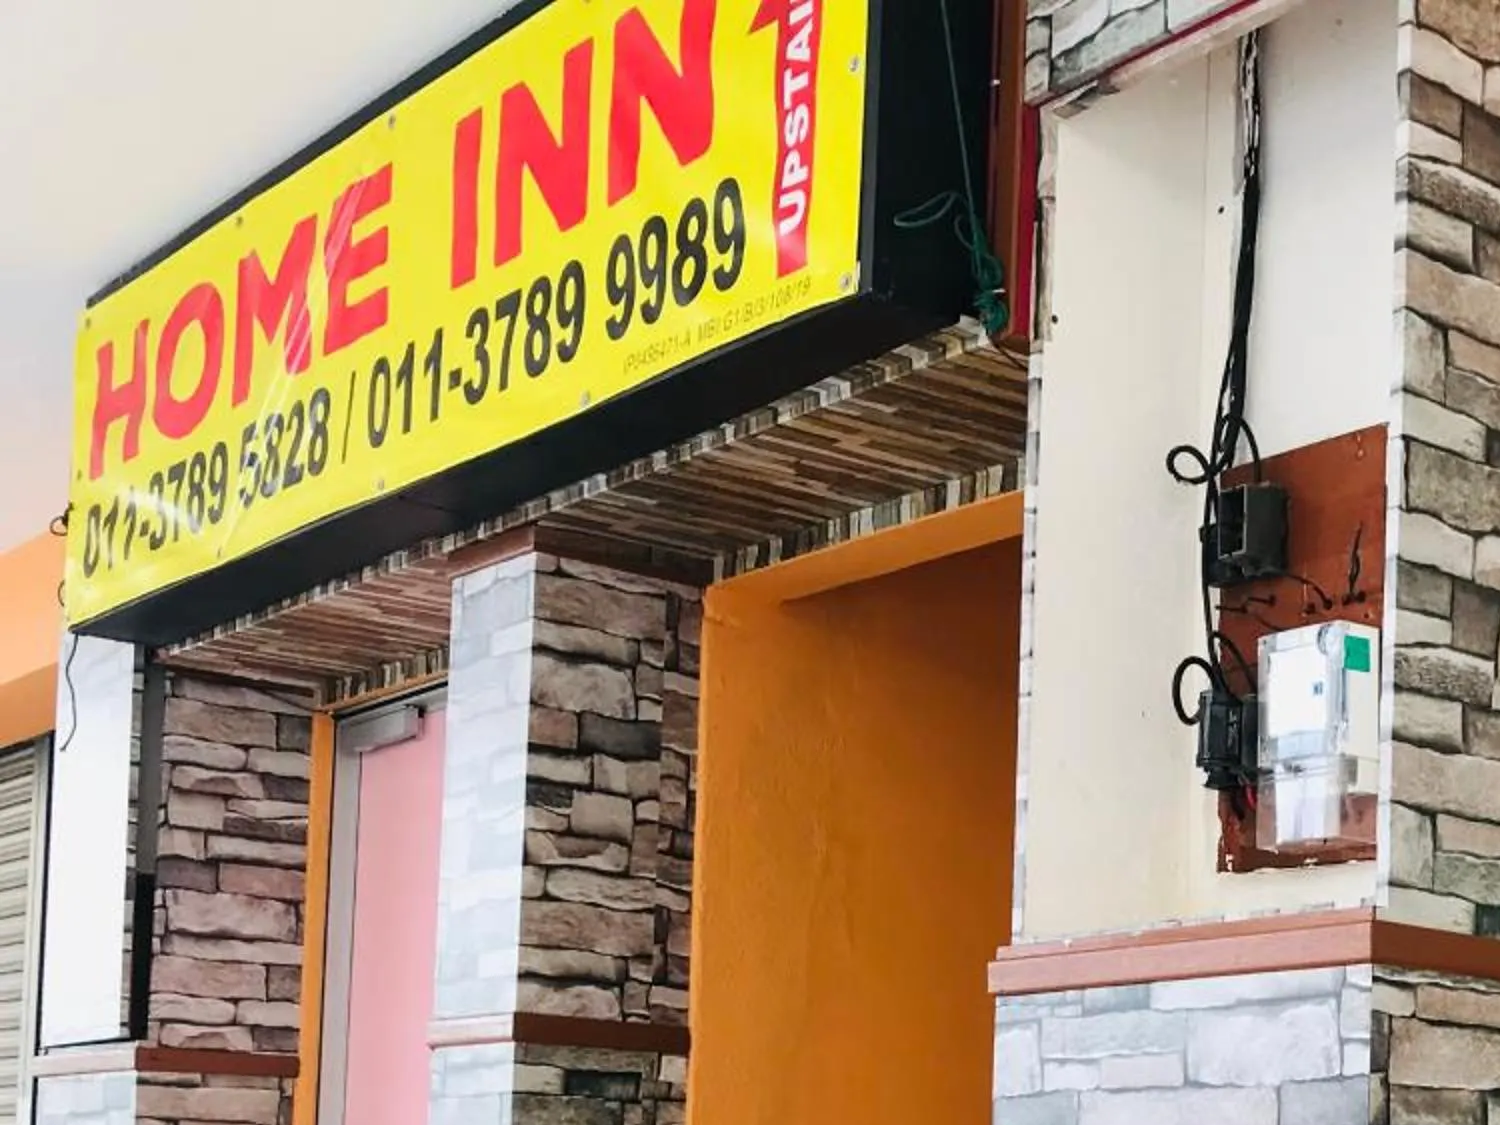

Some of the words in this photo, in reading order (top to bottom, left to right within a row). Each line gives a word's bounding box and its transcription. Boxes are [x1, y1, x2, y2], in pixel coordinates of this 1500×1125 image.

[89, 161, 393, 481] HOME
[450, 0, 717, 290] INN
[778, 0, 814, 237] UPSTAI
[83, 441, 229, 579] 011-3789
[239, 386, 331, 509] 5828
[367, 259, 586, 449] 011-3789
[606, 177, 746, 341] 9989
